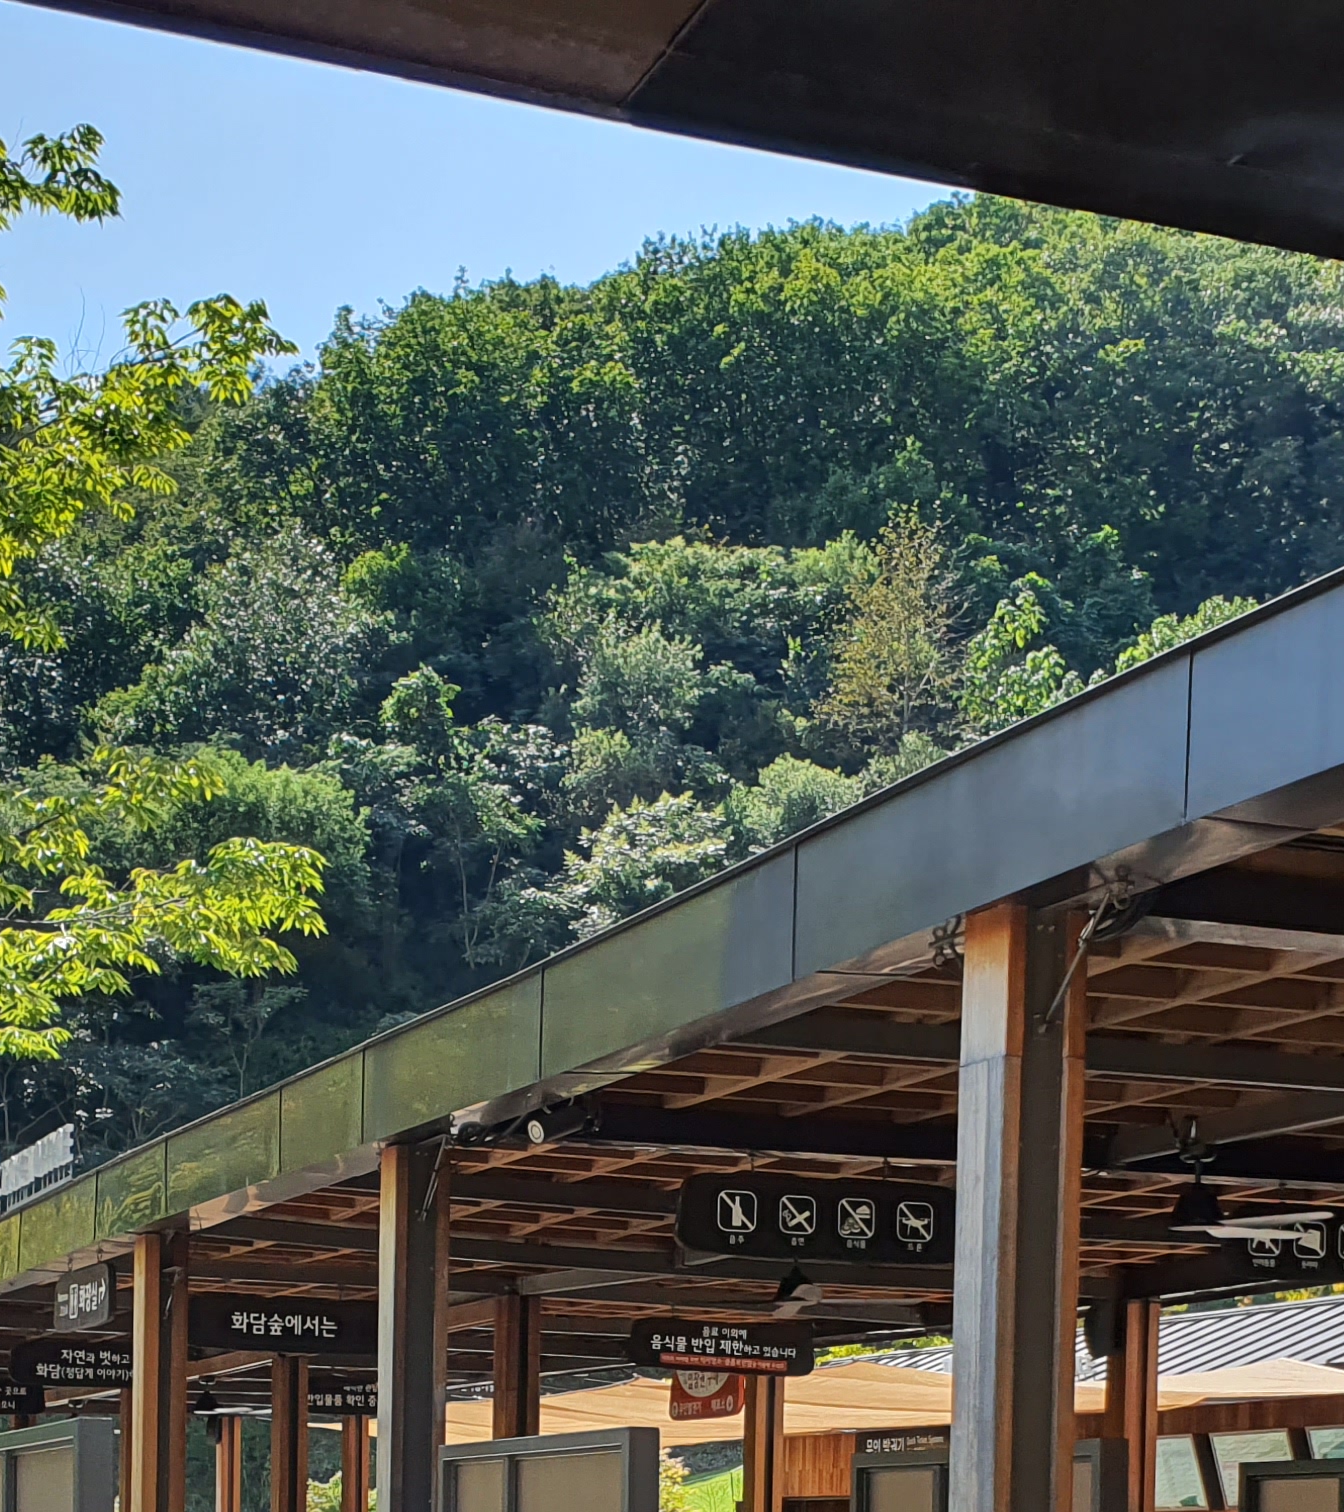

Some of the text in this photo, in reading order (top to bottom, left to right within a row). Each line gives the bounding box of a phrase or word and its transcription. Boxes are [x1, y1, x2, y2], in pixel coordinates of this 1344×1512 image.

[79, 1281, 98, 1313] 화장실
[231, 1311, 338, 1338] 화담숲에서는
[702, 1326, 719, 1337] 음료
[650, 1334, 796, 1358] 음식물 반입 제한하고 있습니다
[60, 1349, 131, 1366] 자연과 벗하고
[97, 1367, 134, 1382] 이야기)
[346, 1394, 365, 1407] 확인
